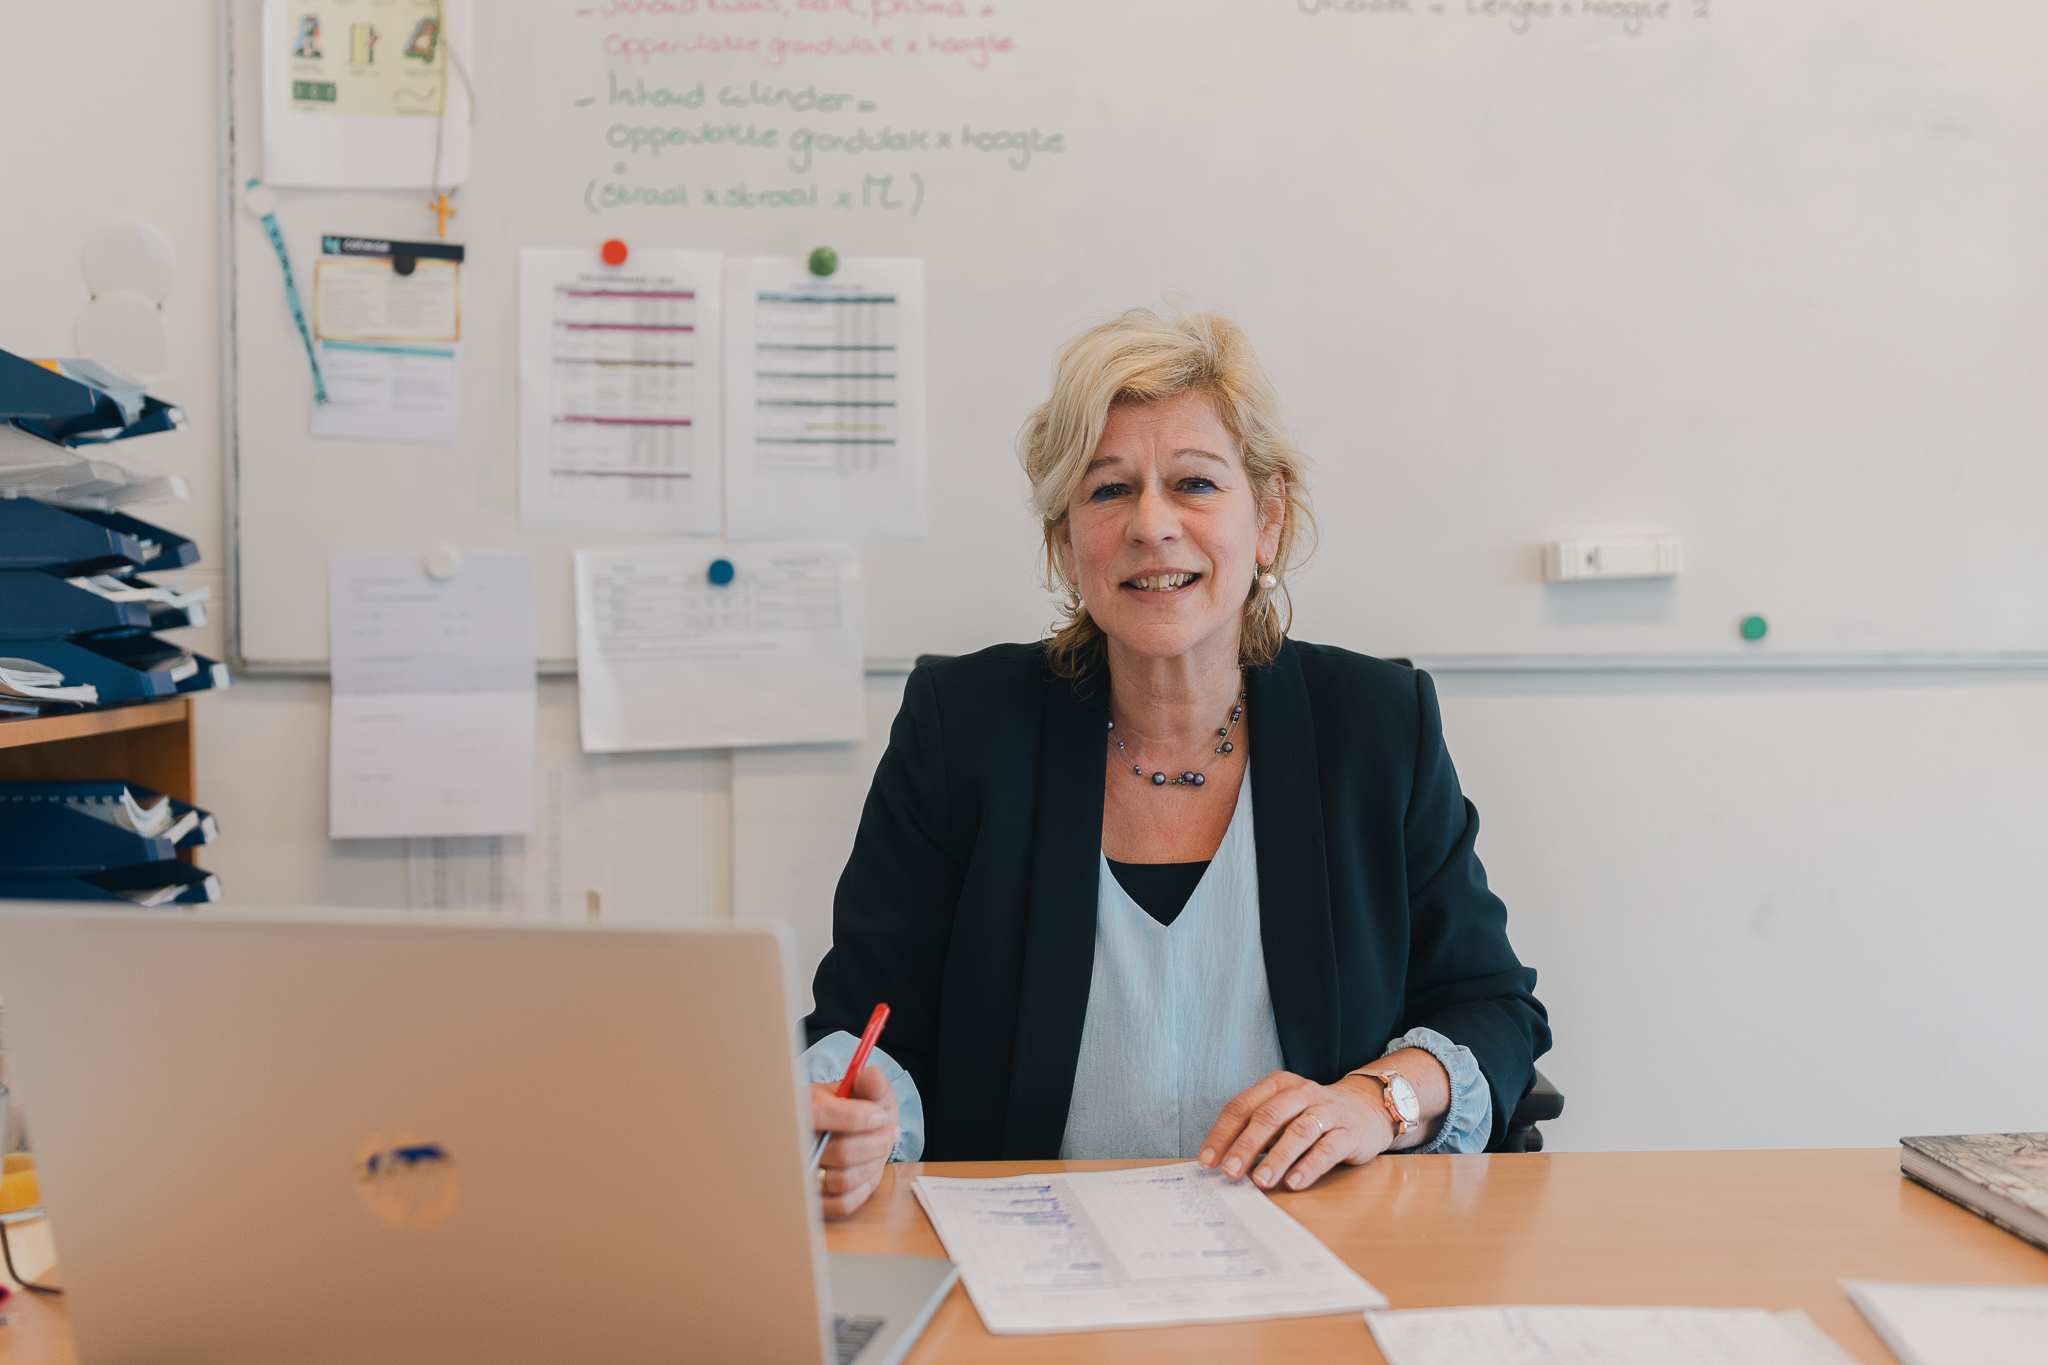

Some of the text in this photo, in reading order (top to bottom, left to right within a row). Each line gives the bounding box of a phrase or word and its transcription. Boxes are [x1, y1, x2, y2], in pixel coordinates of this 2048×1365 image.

[927, 32, 1020, 71] hoogte
[607, 70, 705, 109] Inhoud
[961, 123, 1067, 173] hoogte
